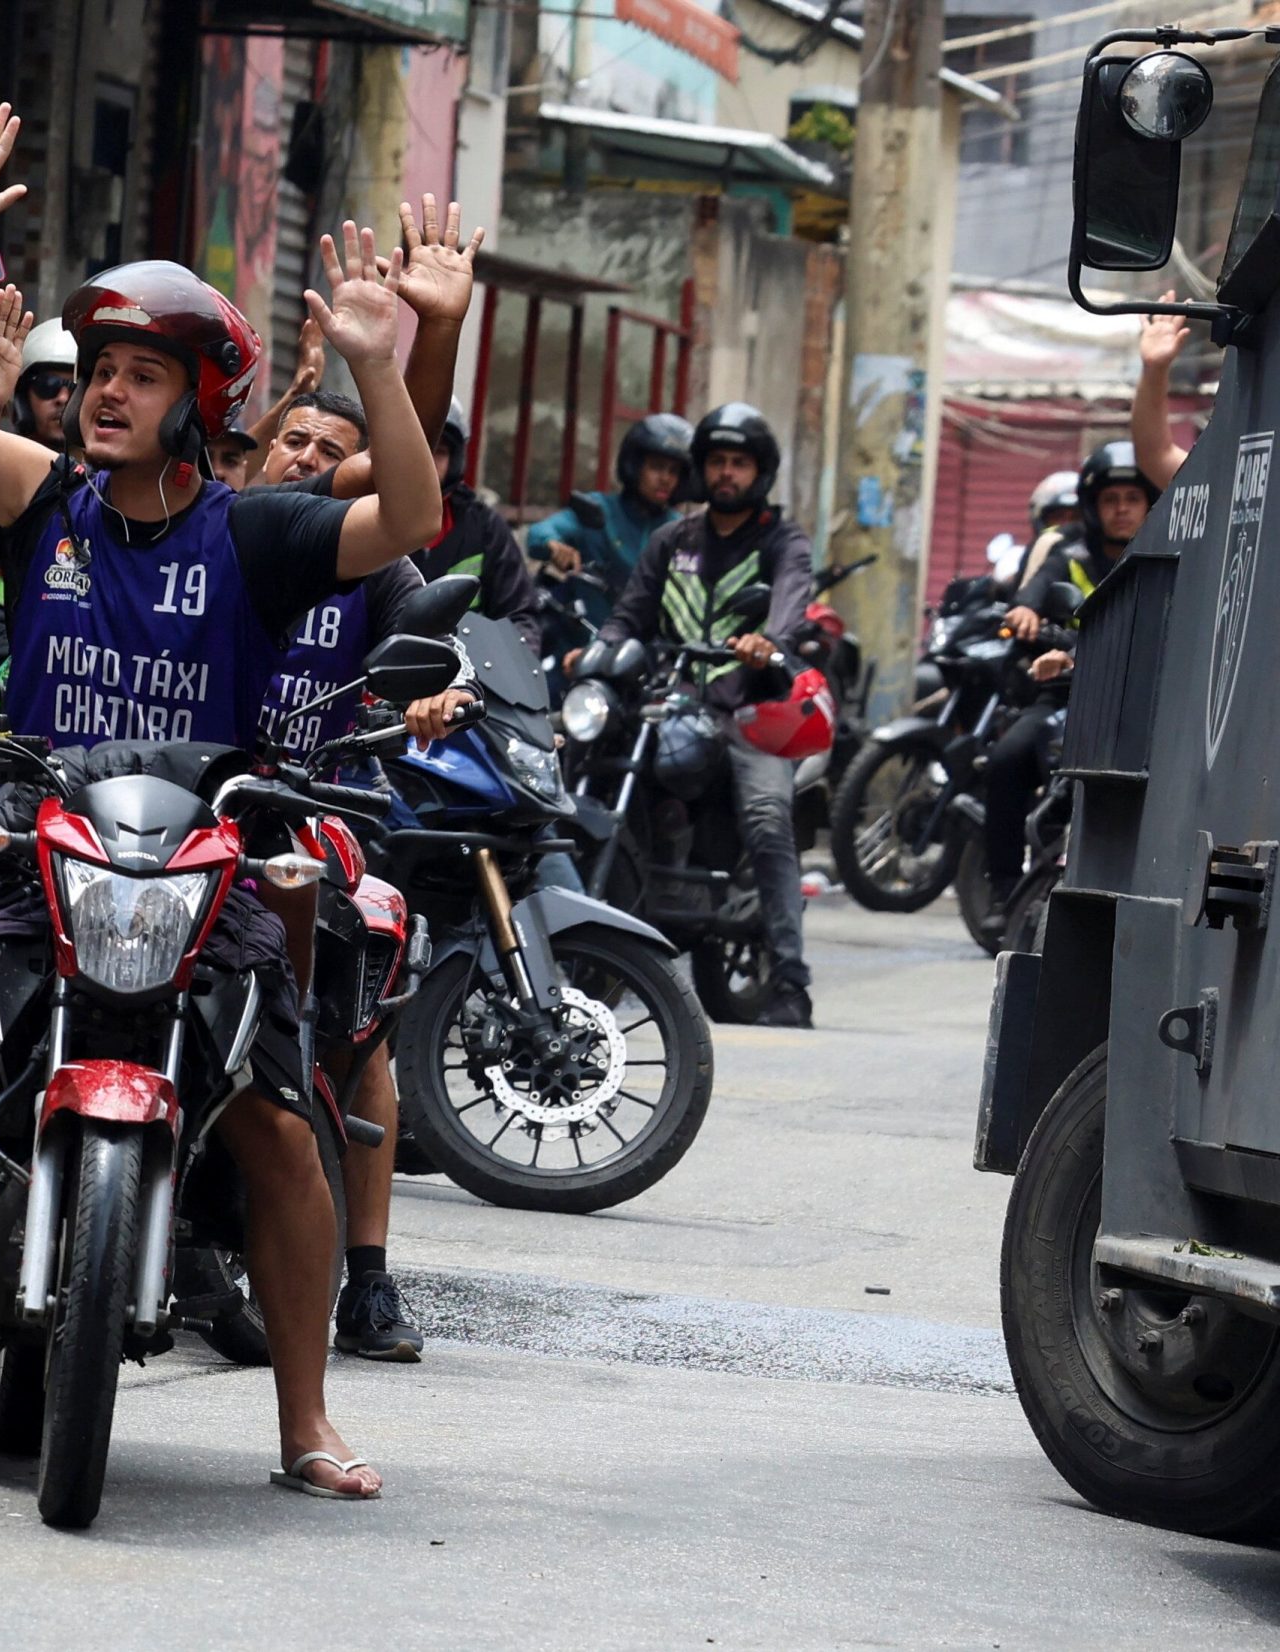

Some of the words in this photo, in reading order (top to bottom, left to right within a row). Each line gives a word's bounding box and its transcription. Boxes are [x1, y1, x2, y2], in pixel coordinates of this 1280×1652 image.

[1168, 483, 1210, 541] 67-0723
[153, 562, 207, 616] 19
[296, 606, 341, 649] 18
[46, 635, 121, 687] MOTO
[131, 649, 209, 702] TÁXI
[117, 850, 159, 863] HONDA
